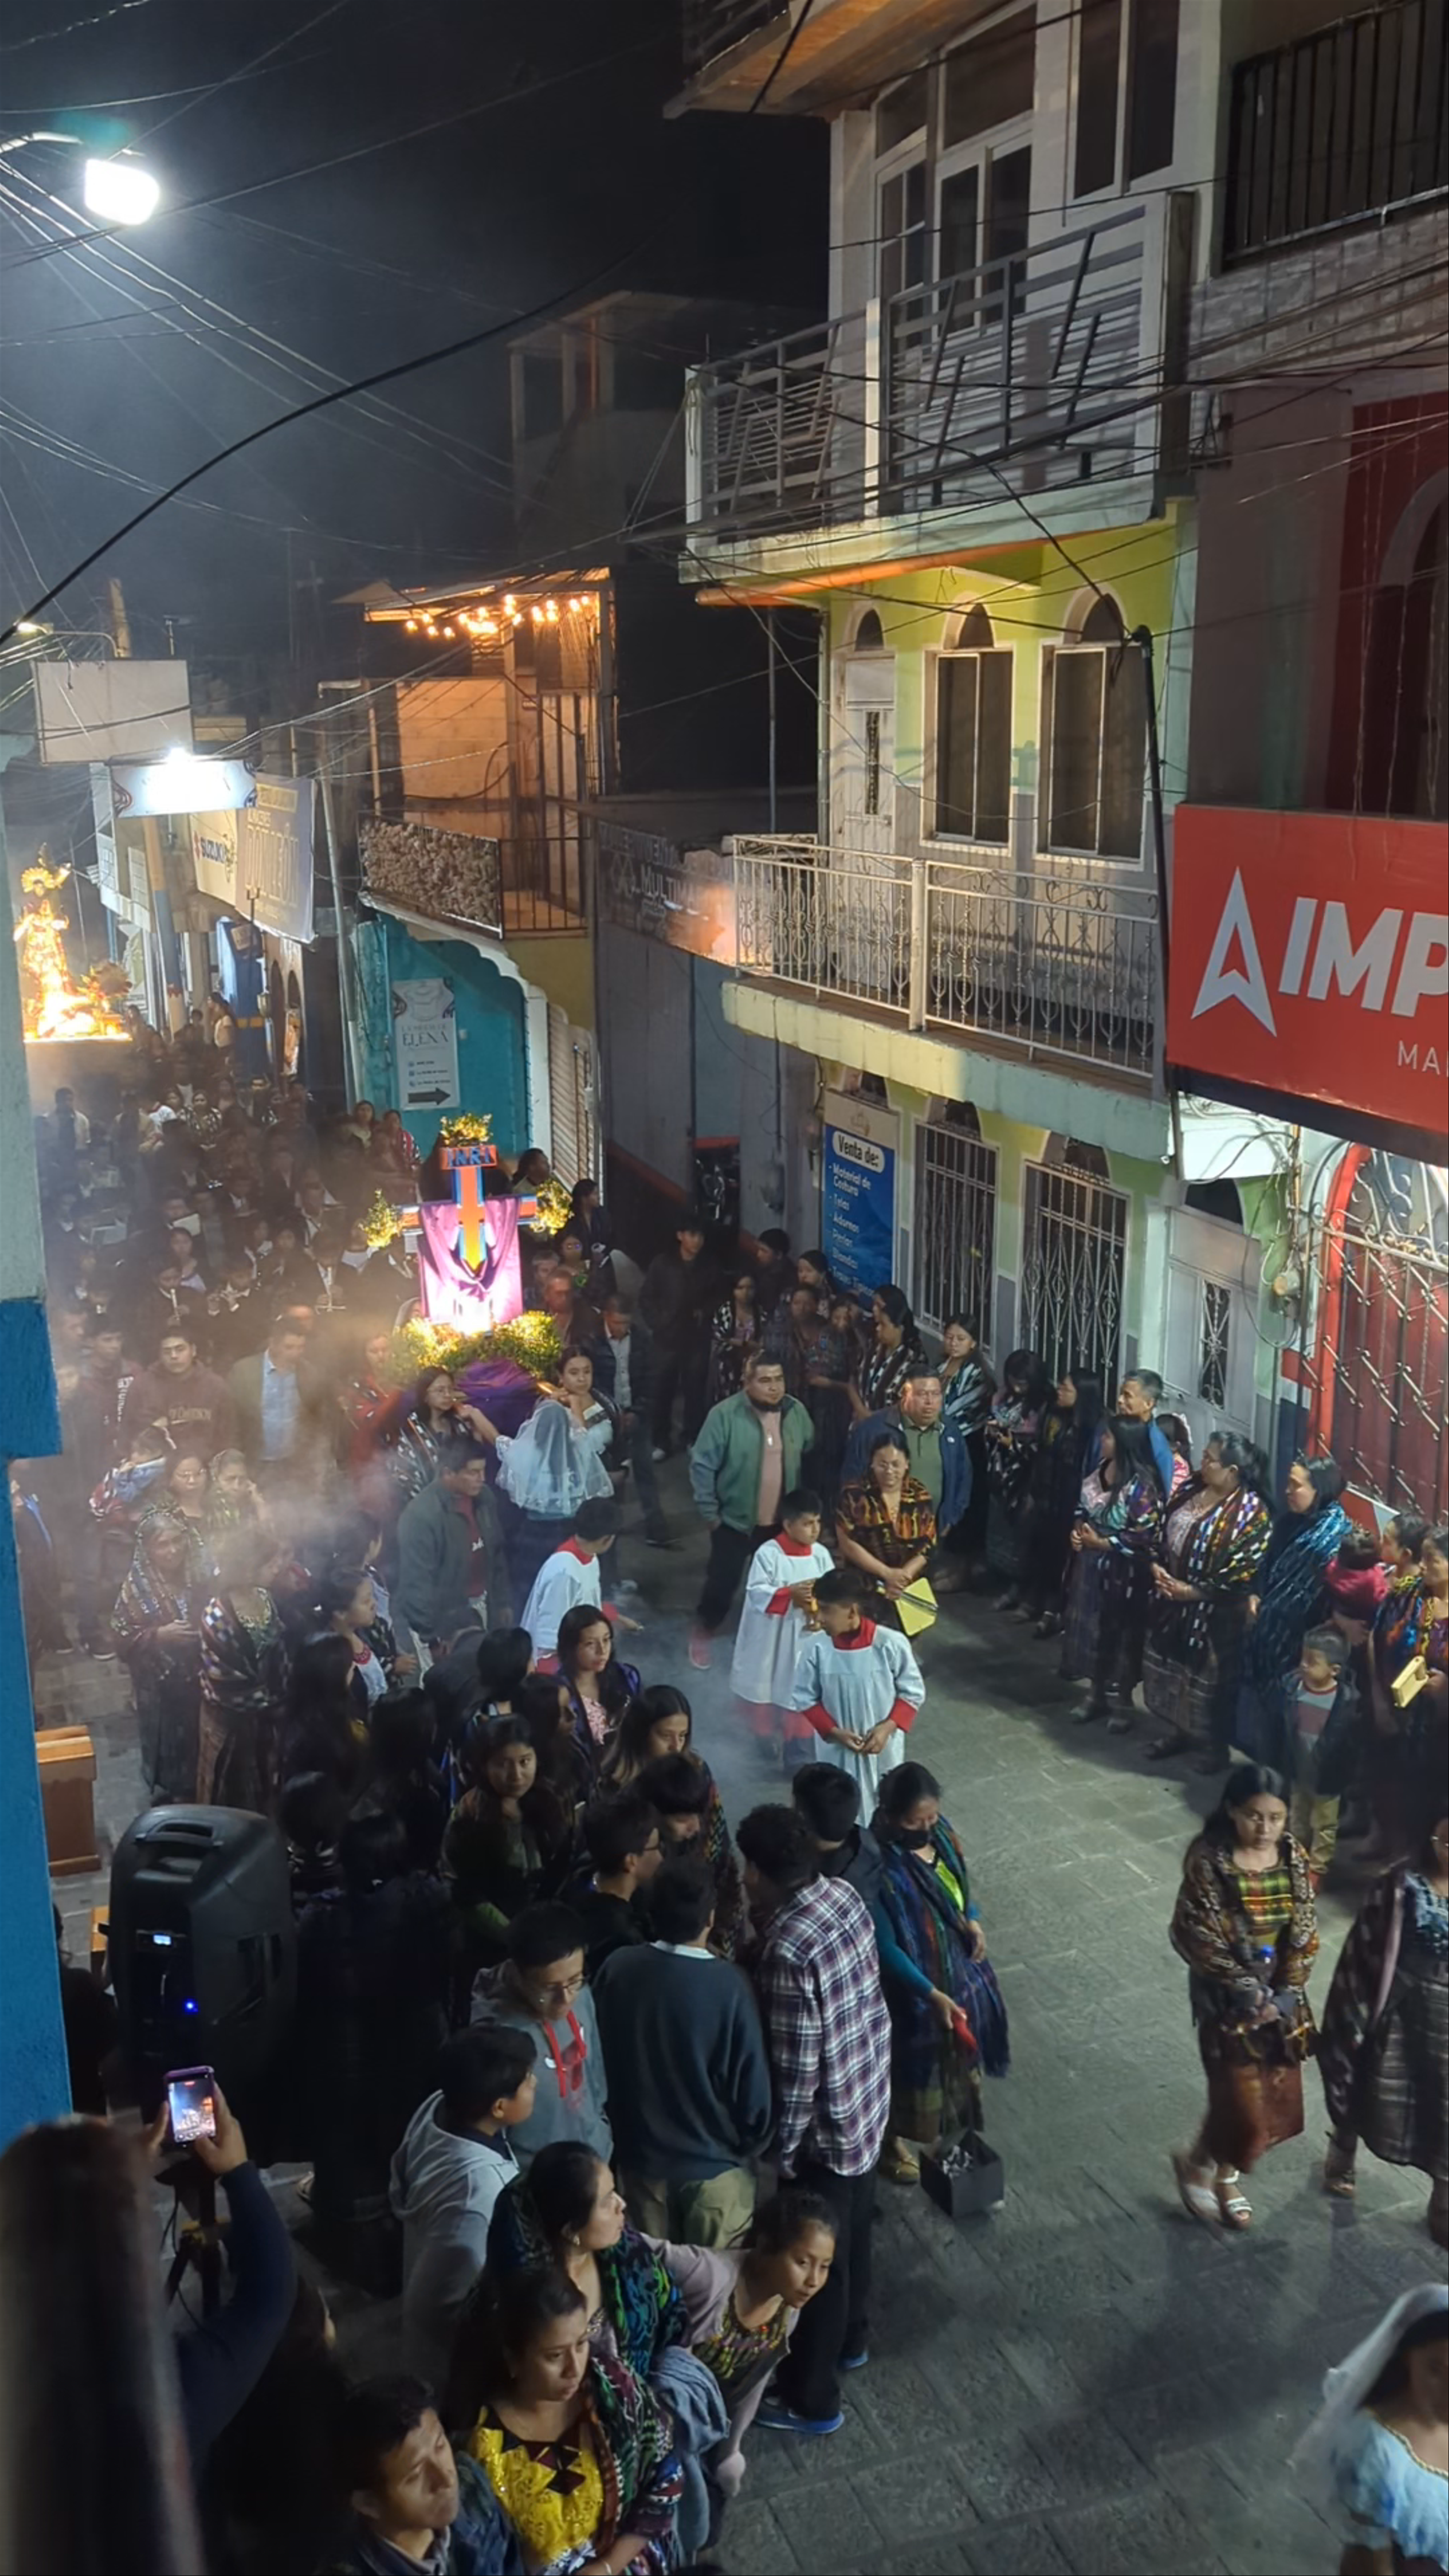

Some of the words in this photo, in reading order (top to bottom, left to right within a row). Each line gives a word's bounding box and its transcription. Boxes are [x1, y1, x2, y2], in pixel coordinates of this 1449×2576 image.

[1398, 1040, 1449, 1077] MA
[448, 1148, 491, 1167] INRI
[838, 1134, 862, 1160] Venta
